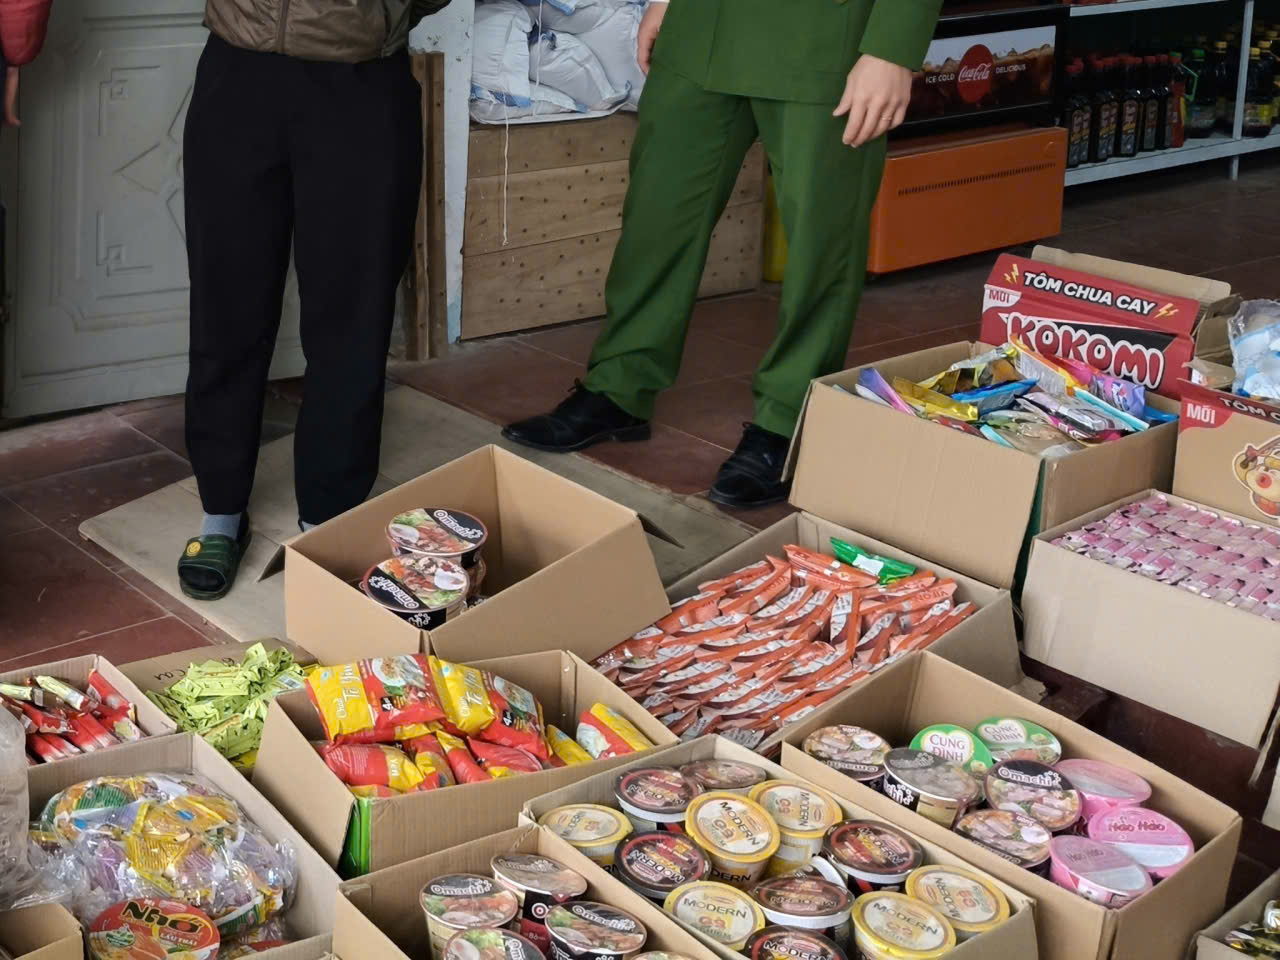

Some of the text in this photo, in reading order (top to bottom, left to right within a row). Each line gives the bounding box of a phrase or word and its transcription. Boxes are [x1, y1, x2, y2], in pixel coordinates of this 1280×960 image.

[925, 73, 955, 84] ICE COLD
[995, 64, 1026, 74] DELICIOUS
[1023, 270, 1156, 316] TÔM CHUA CAY
[1009, 314, 1165, 388] KOKOMI
[1219, 397, 1267, 417] TÔM
[929, 733, 966, 751] CUNG
[998, 766, 1062, 788] Omachi
[719, 801, 761, 847] MODERN
[633, 849, 686, 884] MODERN
[710, 869, 753, 884] DERN
[430, 879, 493, 897] Omachi
[683, 896, 748, 919] MODERN
[872, 901, 939, 936] MODERN
